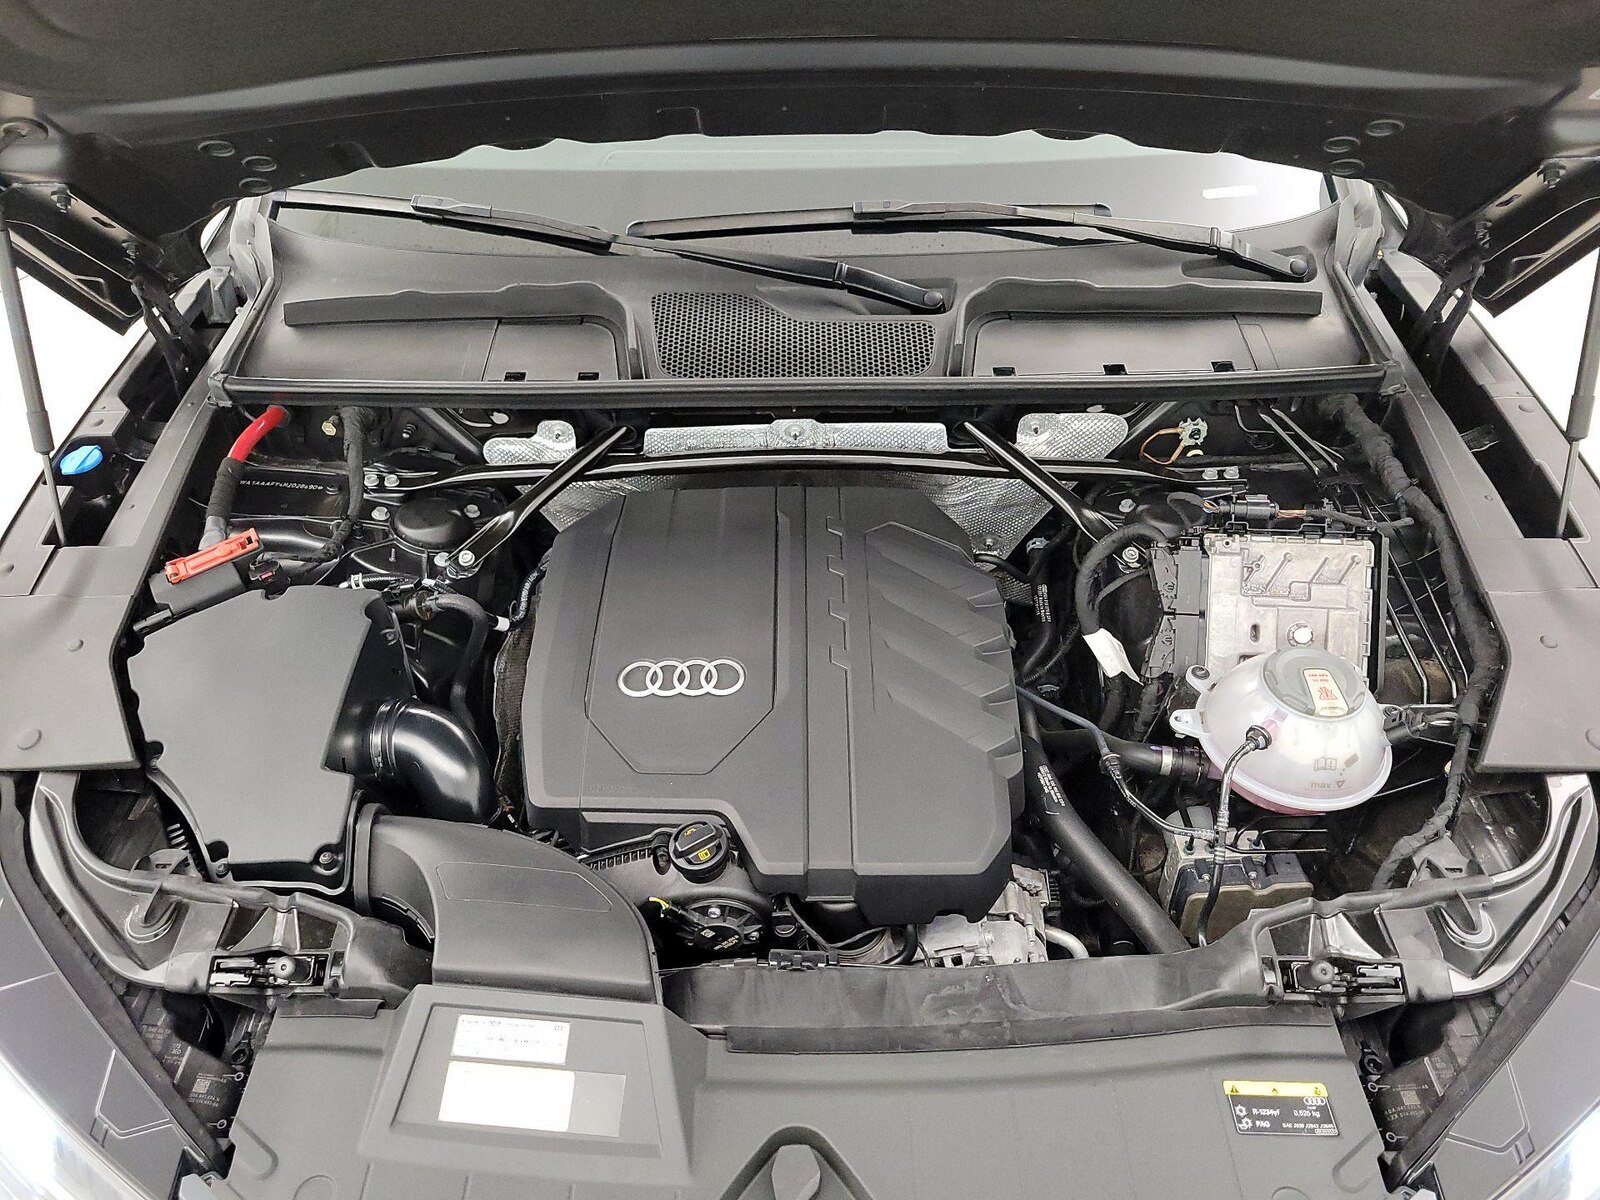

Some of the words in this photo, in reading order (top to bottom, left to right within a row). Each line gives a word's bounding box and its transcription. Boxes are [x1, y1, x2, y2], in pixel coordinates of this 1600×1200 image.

[1310, 781, 1331, 789] max
[1252, 1108, 1280, 1118] R-1234yf
[1312, 1110, 1320, 1118] kg
[1255, 1120, 1271, 1128] PAG
